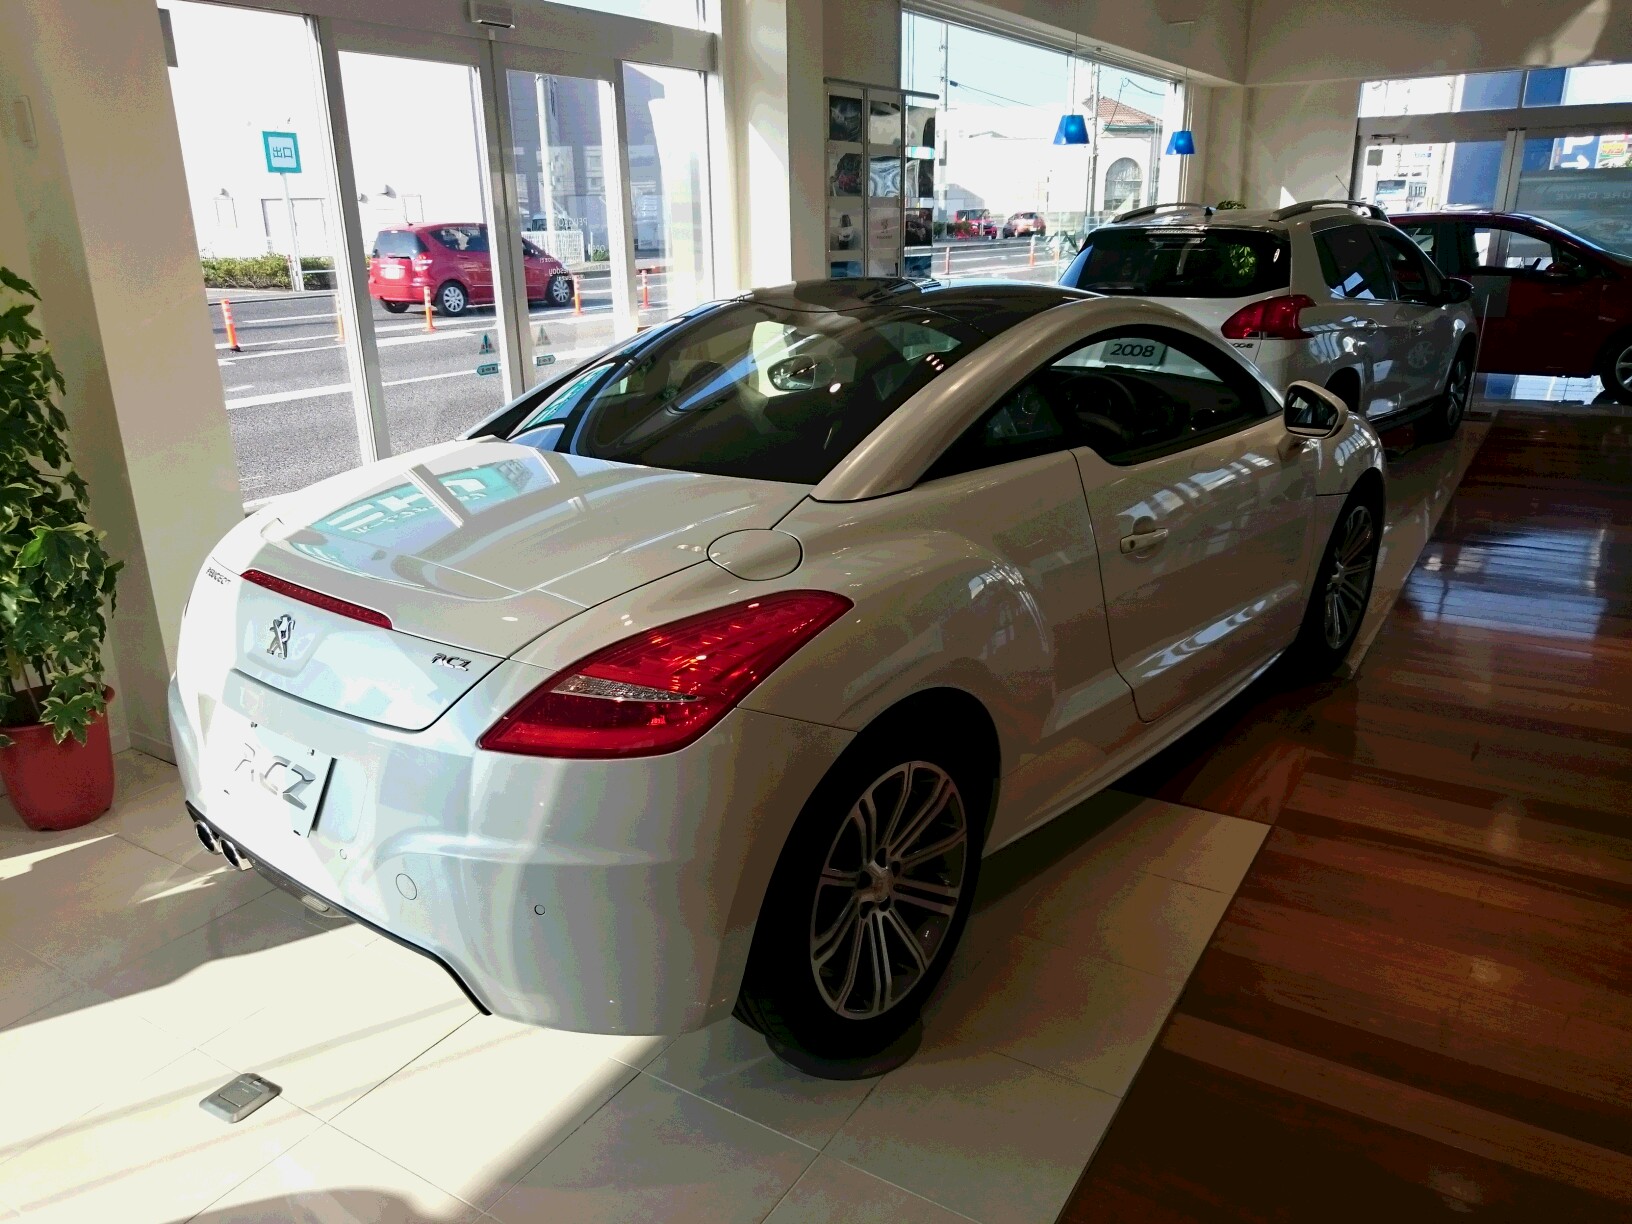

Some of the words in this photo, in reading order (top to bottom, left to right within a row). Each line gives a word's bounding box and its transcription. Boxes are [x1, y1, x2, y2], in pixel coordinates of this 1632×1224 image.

[272, 146, 293, 158] 出口
[1110, 343, 1156, 358] 2008
[431, 653, 472, 671] RCZ
[234, 742, 317, 811] RCZ
